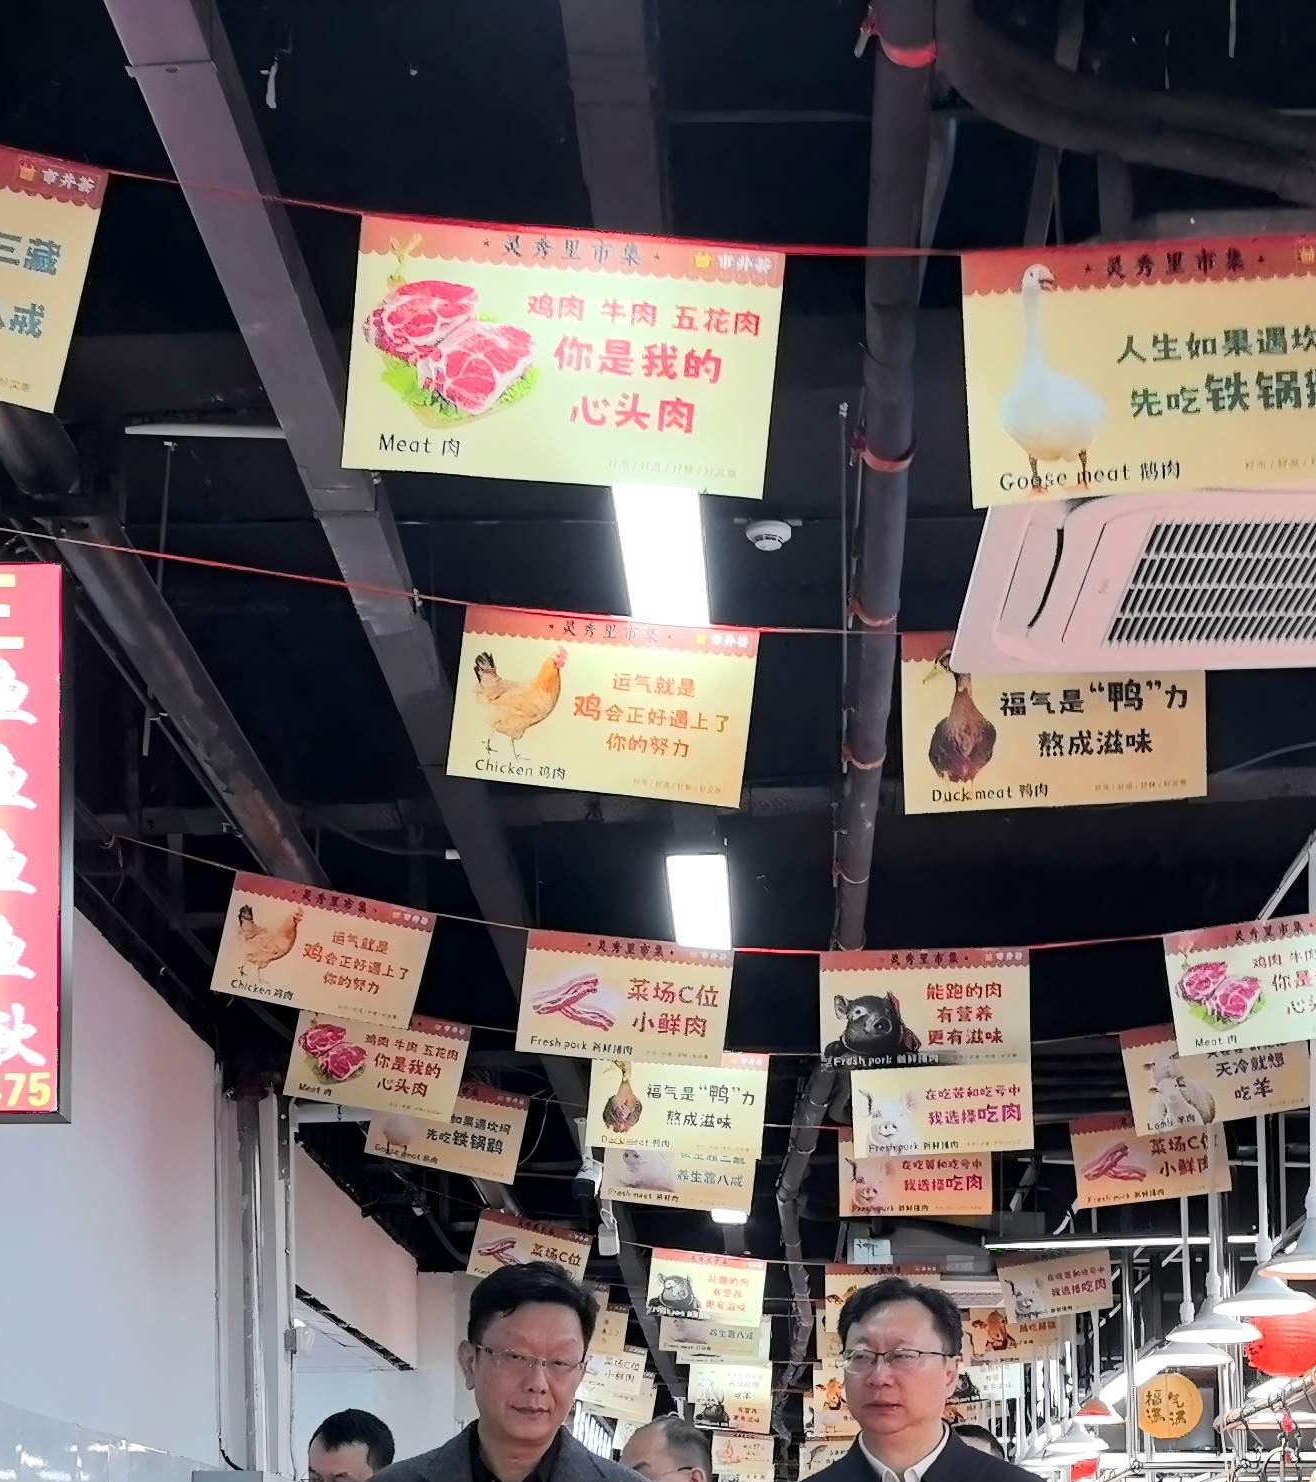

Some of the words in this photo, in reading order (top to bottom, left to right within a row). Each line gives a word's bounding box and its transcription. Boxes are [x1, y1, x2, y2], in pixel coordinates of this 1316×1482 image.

[502, 234, 643, 267] 灵秀里市集
[1106, 247, 1245, 278] 灵秀里市集
[528, 294, 585, 321] 鸡肉
[600, 301, 657, 327] 牛肉
[675, 306, 762, 337] 五花肉
[553, 334, 723, 384] 你是我的
[569, 392, 695, 435] 心头肉
[379, 434, 432, 455] Meat
[442, 437, 461, 457] 肉
[999, 470, 1067, 492] Goose
[1077, 463, 1131, 488] meat
[1140, 459, 1180, 482] 鹅肉
[562, 620, 659, 643] 灵秀里市集
[612, 672, 696, 698] 运气就是
[1000, 678, 1188, 717] 福气是“鸭”力
[573, 693, 730, 733] 鸡会正好遇上了
[606, 732, 690, 759] 你的努力
[1038, 728, 1154, 757] 熬成滋味
[476, 759, 533, 777] Chicken
[539, 766, 566, 781] 鸡肉
[932, 789, 970, 803] Duck
[975, 787, 1012, 801] meat
[1019, 782, 1049, 798] 鸭肉
[332, 931, 389, 954] 运气就是
[598, 939, 664, 957] 灵秀里市集
[303, 942, 410, 980] 鸡会正好遇上了
[1253, 953, 1283, 969] 鸡肉
[231, 979, 272, 997] Chicken
[323, 971, 380, 994] 你的努力
[627, 977, 719, 1008] 菜场C位
[926, 982, 1002, 1000] 能跑的肉
[632, 1012, 707, 1037] 小鲜肉
[937, 1005, 993, 1023] 有营养
[365, 1033, 389, 1048] 鸡肉
[395, 1039, 417, 1054] 牛肉
[422, 1043, 459, 1061] 五花肉
[530, 1036, 561, 1048] Fresh
[564, 1040, 587, 1051] pork
[927, 1027, 1004, 1046] 更有滋味
[1195, 1036, 1222, 1048] Meat
[373, 1052, 441, 1079] 你是我的
[833, 1055, 865, 1066] Fresh
[868, 1055, 892, 1067] pork
[1216, 1053, 1284, 1078] 天冷就想
[299, 1082, 321, 1095] Meat
[377, 1078, 428, 1098] 心头肉
[1235, 1077, 1273, 1101] 吃羊
[666, 1110, 732, 1129] 熬成滋味
[928, 1103, 1021, 1126] 我选择吃肉
[426, 1128, 503, 1155] 先吃铁锅鹅
[677, 1169, 743, 1188] 养生靠八戒
[904, 1175, 983, 1192] 我选择吃肉
